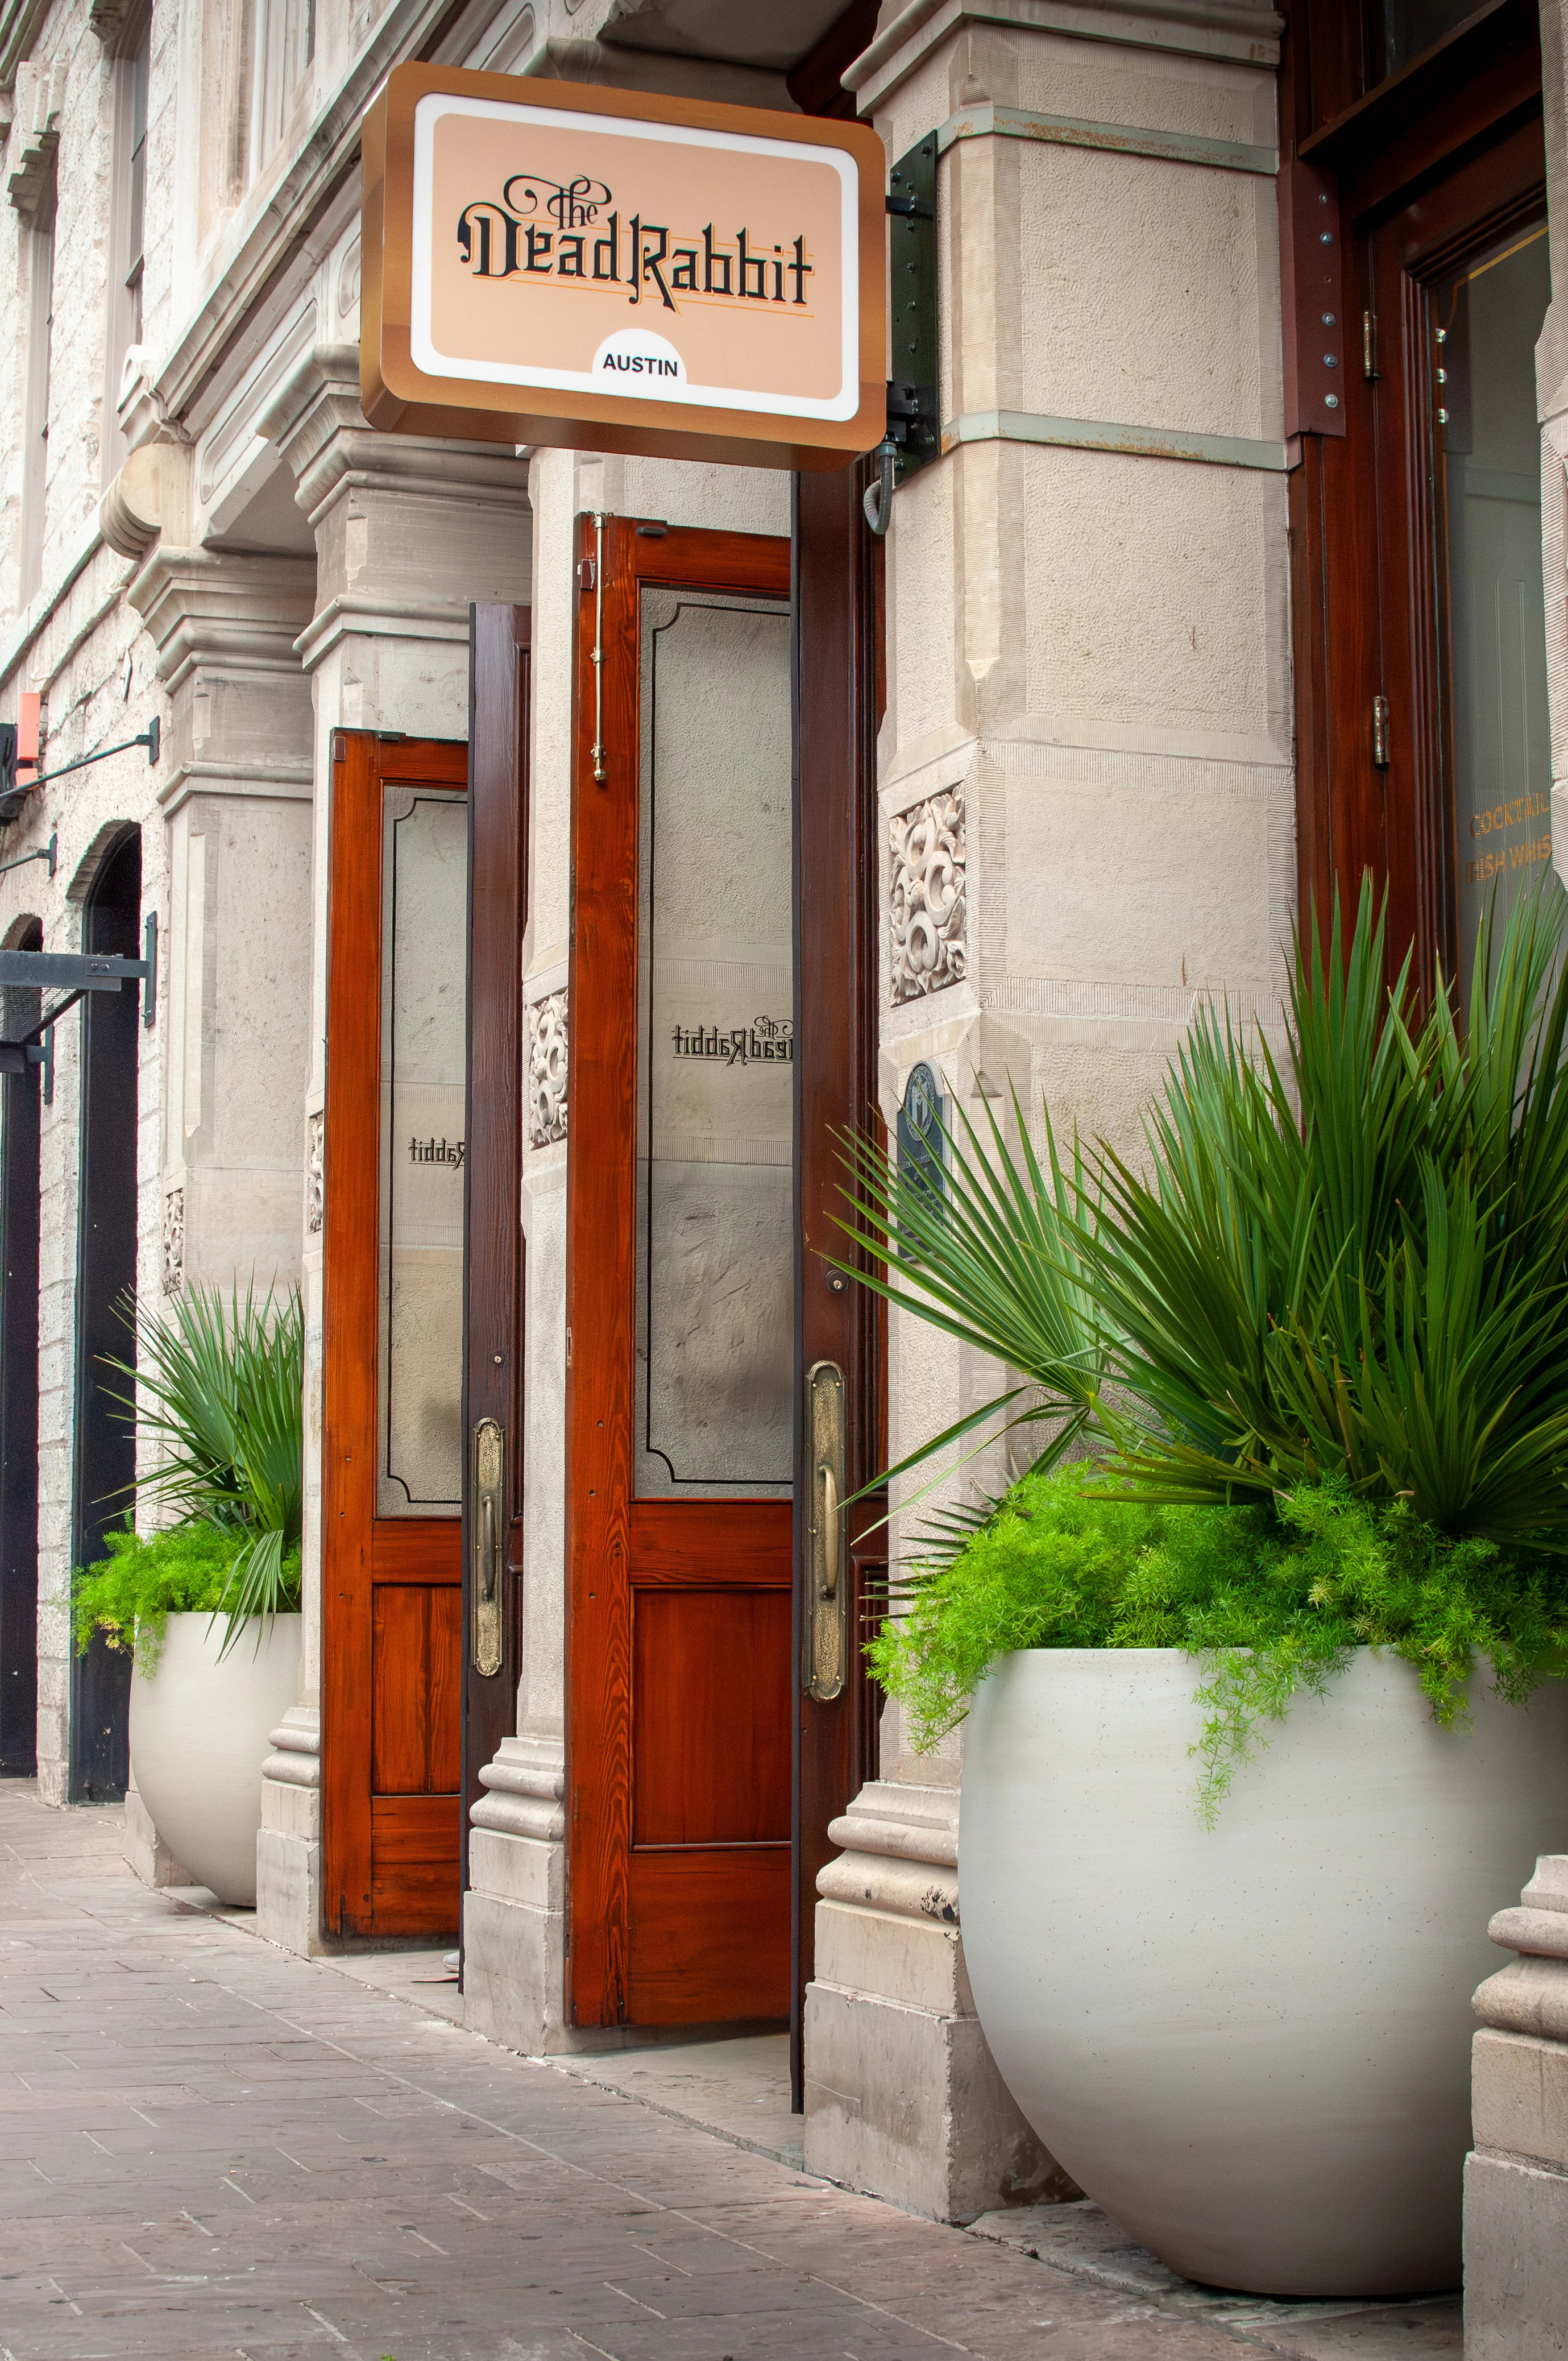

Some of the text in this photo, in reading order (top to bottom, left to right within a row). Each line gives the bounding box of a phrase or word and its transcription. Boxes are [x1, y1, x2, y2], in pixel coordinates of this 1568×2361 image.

[503, 174, 612, 230] The
[457, 201, 814, 313] Dead Rabbit
[603, 353, 678, 378] AUSTIN
